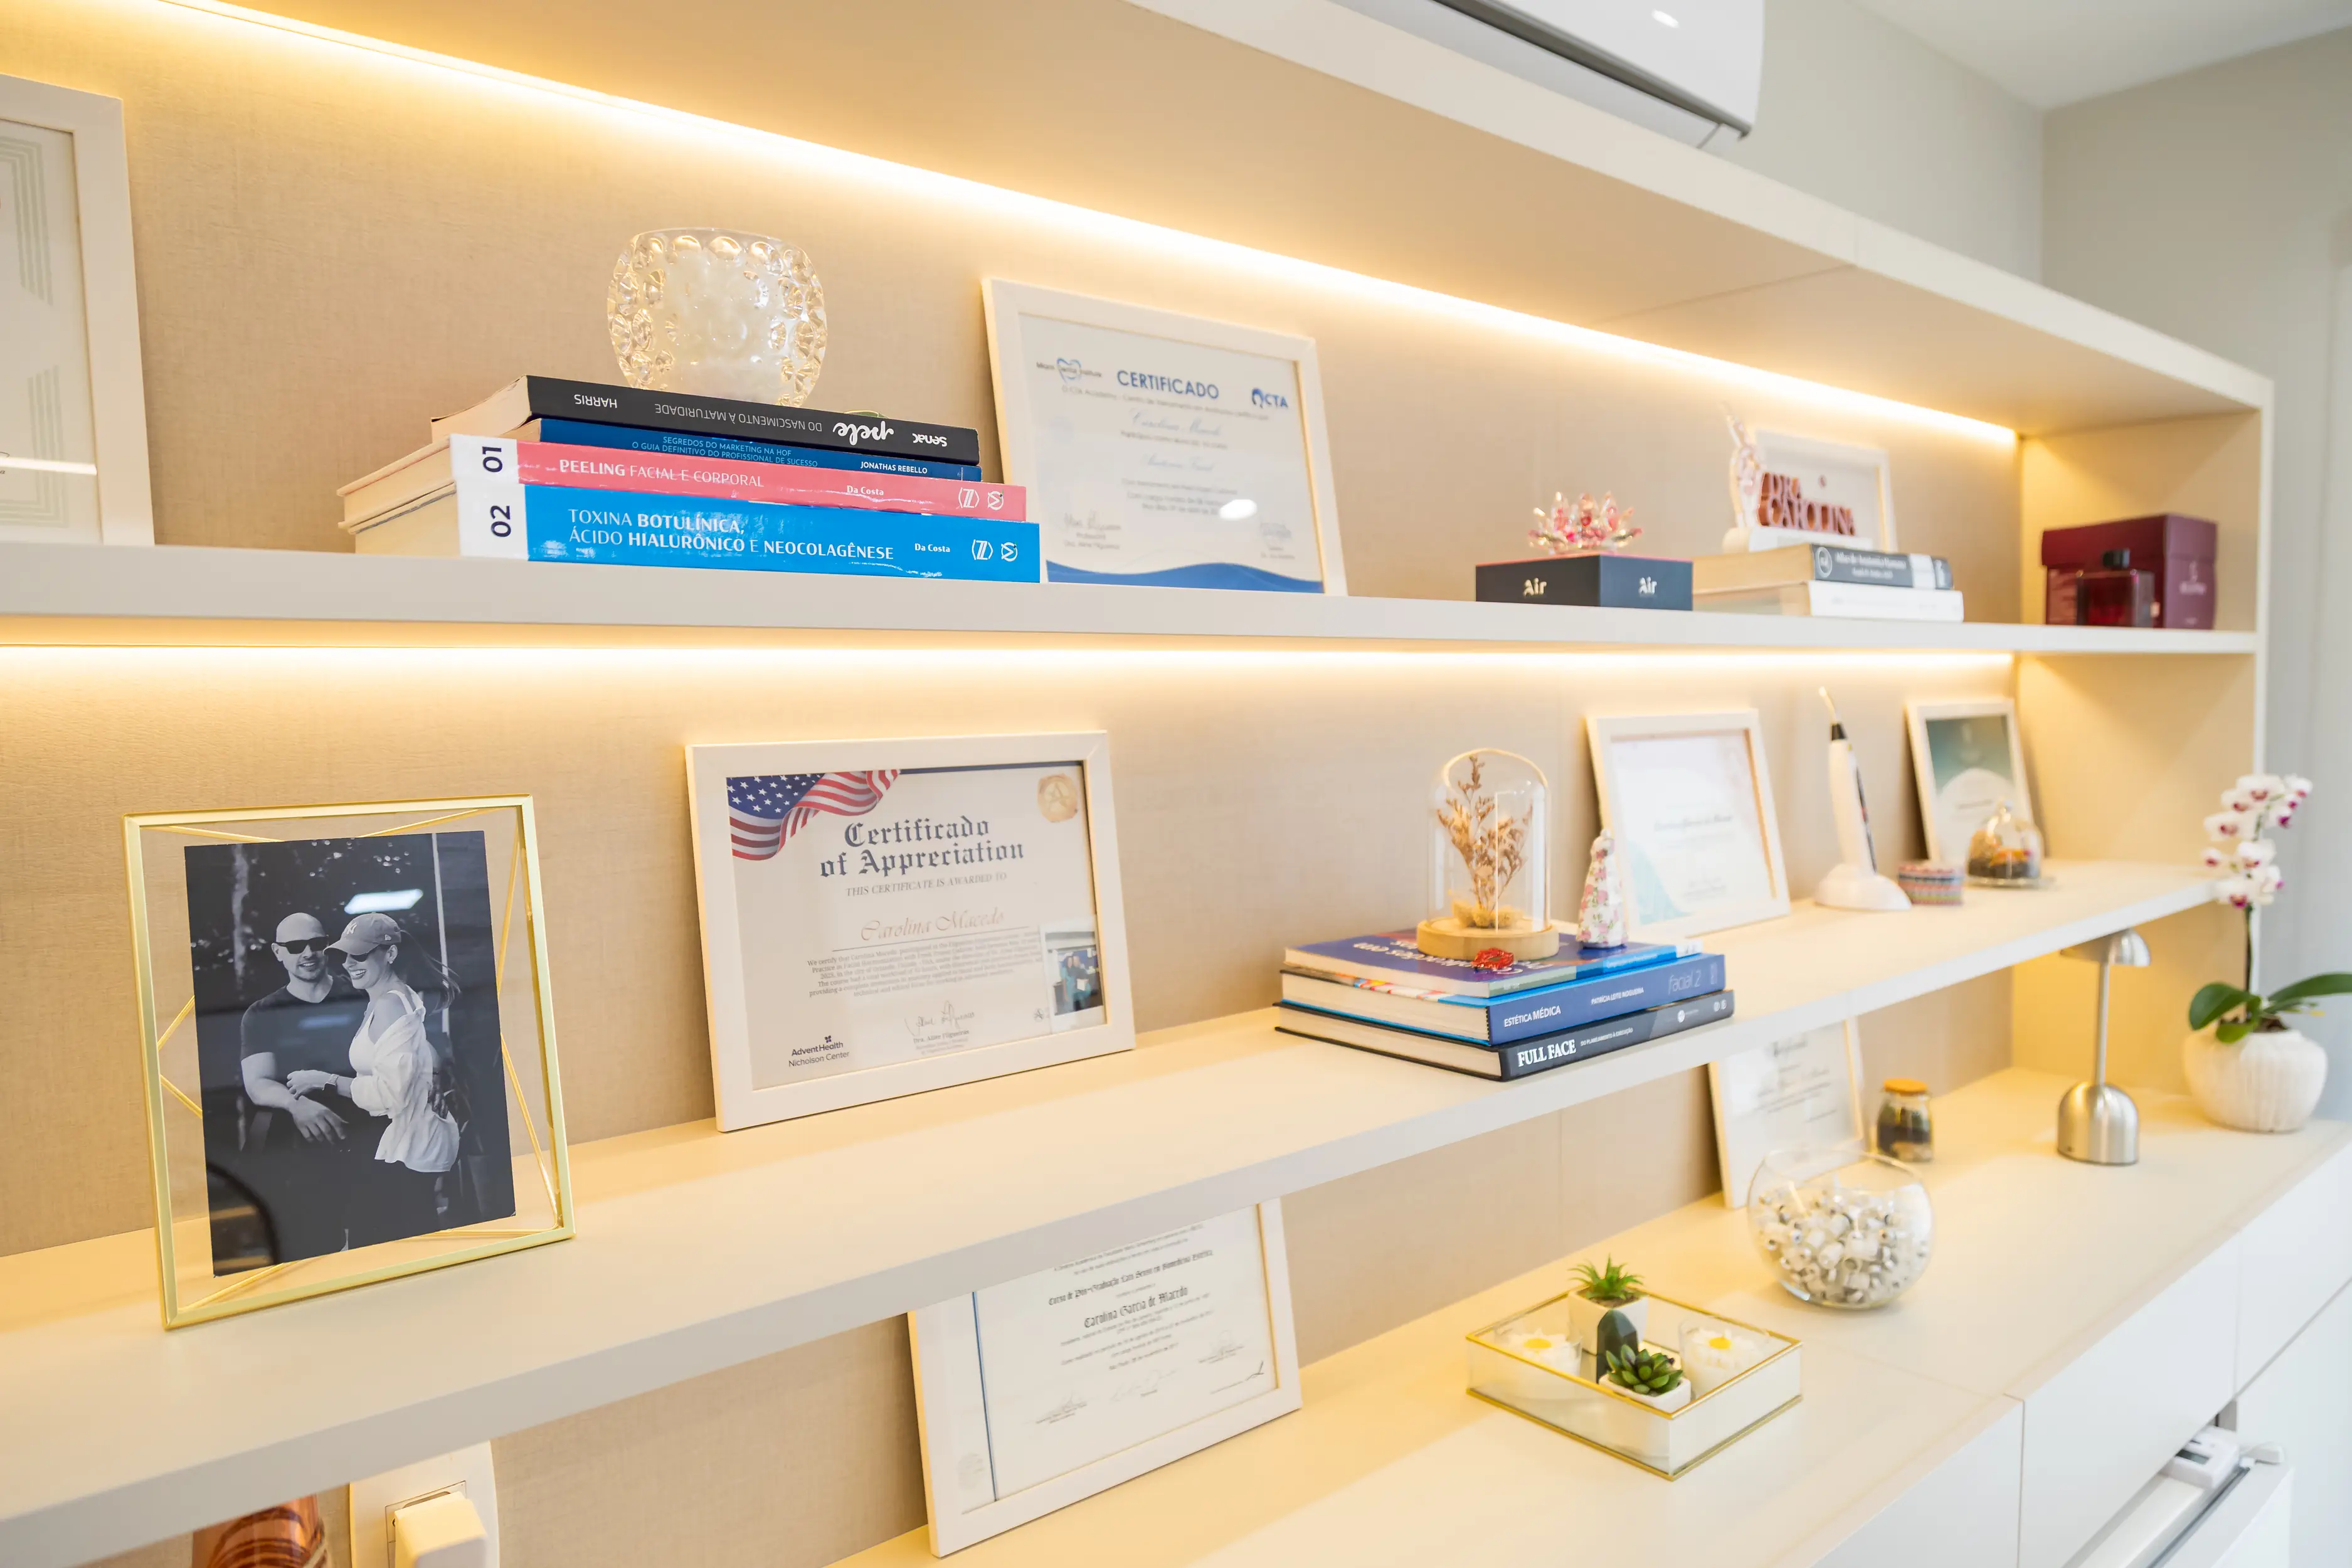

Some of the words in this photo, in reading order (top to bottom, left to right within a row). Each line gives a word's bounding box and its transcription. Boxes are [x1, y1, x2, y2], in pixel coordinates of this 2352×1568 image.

[1117, 370, 1219, 399] CERTIFICADO
[573, 394, 618, 409] HARRIS
[654, 403, 727, 421] MATURIDADE
[728, 412, 736, 425] À
[738, 413, 806, 431] NASCIMENTO
[808, 421, 823, 432] DO
[832, 420, 894, 446] pele
[632, 441, 639, 449] O
[641, 443, 660, 451] GUIA
[662, 444, 706, 457] DEFINITIVO
[707, 449, 720, 458] DO
[721, 451, 773, 464] PROFISSIONAL
[775, 456, 785, 464] DE
[787, 458, 818, 468] SUCESSO
[663, 436, 704, 448] SEGREDOS
[706, 440, 718, 449] DO
[719, 443, 762, 455] MARKETING
[764, 447, 775, 455] NA
[776, 448, 792, 457] HOF
[481, 445, 503, 474] 01
[860, 461, 896, 472] JONATHAS
[898, 464, 928, 475] REBELLO
[559, 459, 626, 477] PEELING
[629, 465, 677, 481] FACIAL
[681, 469, 689, 482] E
[693, 470, 765, 488] CORPORAL
[847, 485, 859, 494] Da
[861, 486, 884, 496] Costa
[489, 504, 512, 538] 02
[568, 507, 633, 527] TOXINA
[637, 510, 745, 535] BOTULÍNICA,
[569, 526, 623, 545] ÁCIDO
[628, 531, 746, 553] HIALURÔNICO
[750, 538, 759, 553] E
[764, 540, 894, 560] NEOCOLAGÊNESE
[914, 543, 926, 552] Da
[928, 544, 951, 553] Costa
[1523, 578, 1547, 596] Air
[1639, 576, 1657, 595] Air
[844, 815, 990, 847] Certificado
[819, 852, 848, 878] of
[858, 839, 1025, 878] Appreciation
[845, 886, 869, 897] THIS
[871, 879, 933, 895] CERTIFICATE
[936, 878, 945, 888] IS
[946, 872, 992, 887] AWARDED
[995, 871, 1007, 881] TO
[860, 916, 933, 941] Carolina
[935, 905, 1005, 931] Macedo
[1694, 970, 1702, 988] 2
[1503, 1012, 1532, 1028] ESTÉTICA
[1532, 1004, 1562, 1021] MÉDICA
[788, 1056, 825, 1067] Nicholson
[825, 1051, 850, 1061] Center
[1517, 1047, 1547, 1067] FULL
[1547, 1039, 1577, 1061] FACE
